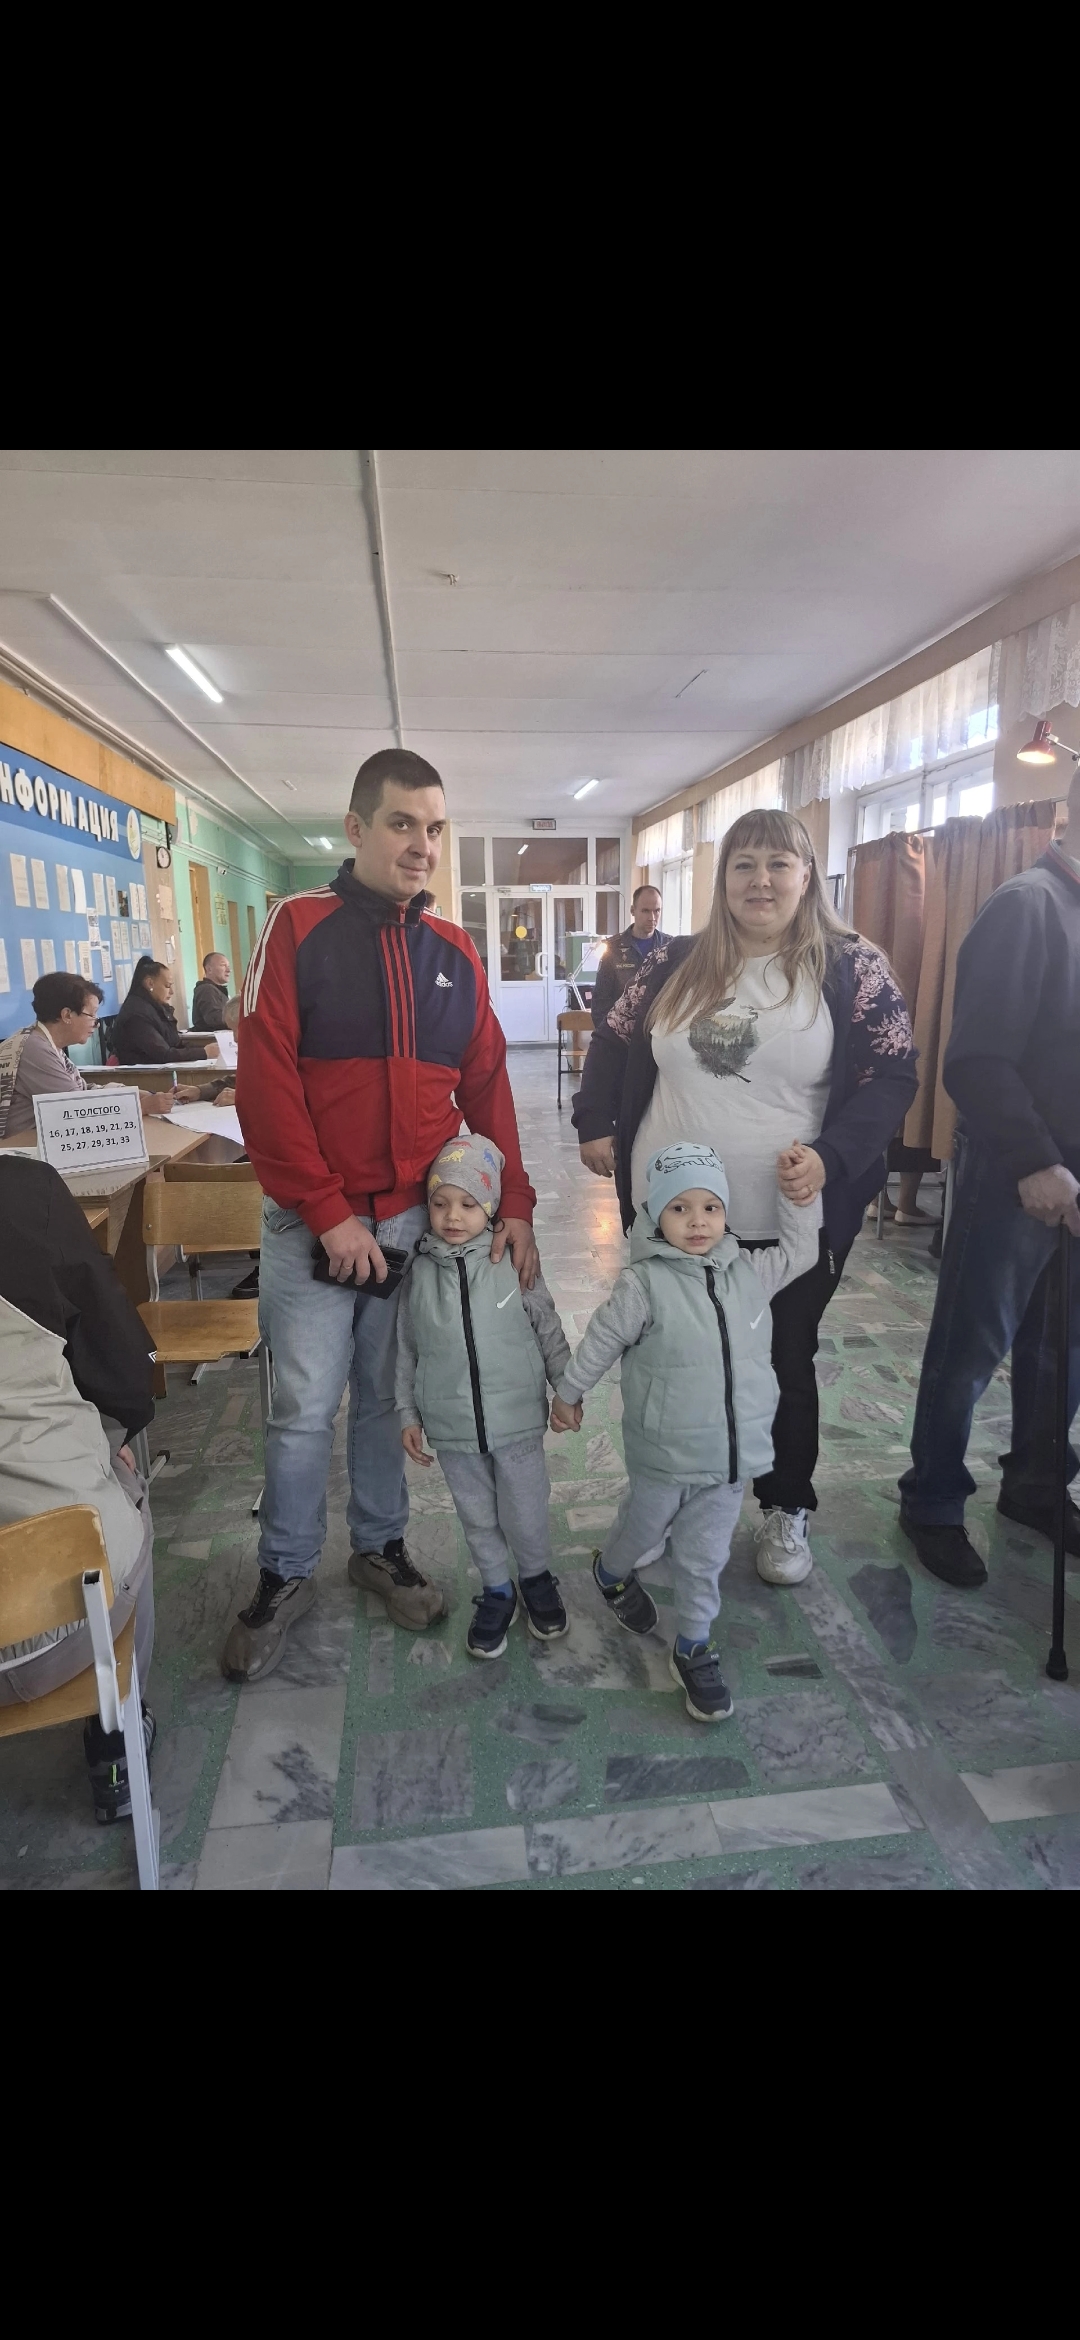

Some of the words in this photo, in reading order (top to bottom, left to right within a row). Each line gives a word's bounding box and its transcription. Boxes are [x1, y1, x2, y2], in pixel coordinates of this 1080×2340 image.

[63, 1110, 73, 1119] Л.
[74, 1105, 121, 1118] ТОЛСТОГО
[49, 1129, 63, 1138] 16,
[65, 1127, 79, 1137] 17,
[81, 1126, 94, 1135] 18,
[95, 1124, 109, 1133] 19,
[110, 1122, 123, 1131] 21,
[124, 1121, 137, 1130] 23,
[61, 1143, 75, 1152] 25,
[76, 1141, 90, 1150] 27,
[91, 1139, 104, 1148] 29,
[106, 1137, 119, 1146] 31,
[120, 1135, 130, 1144] 33
